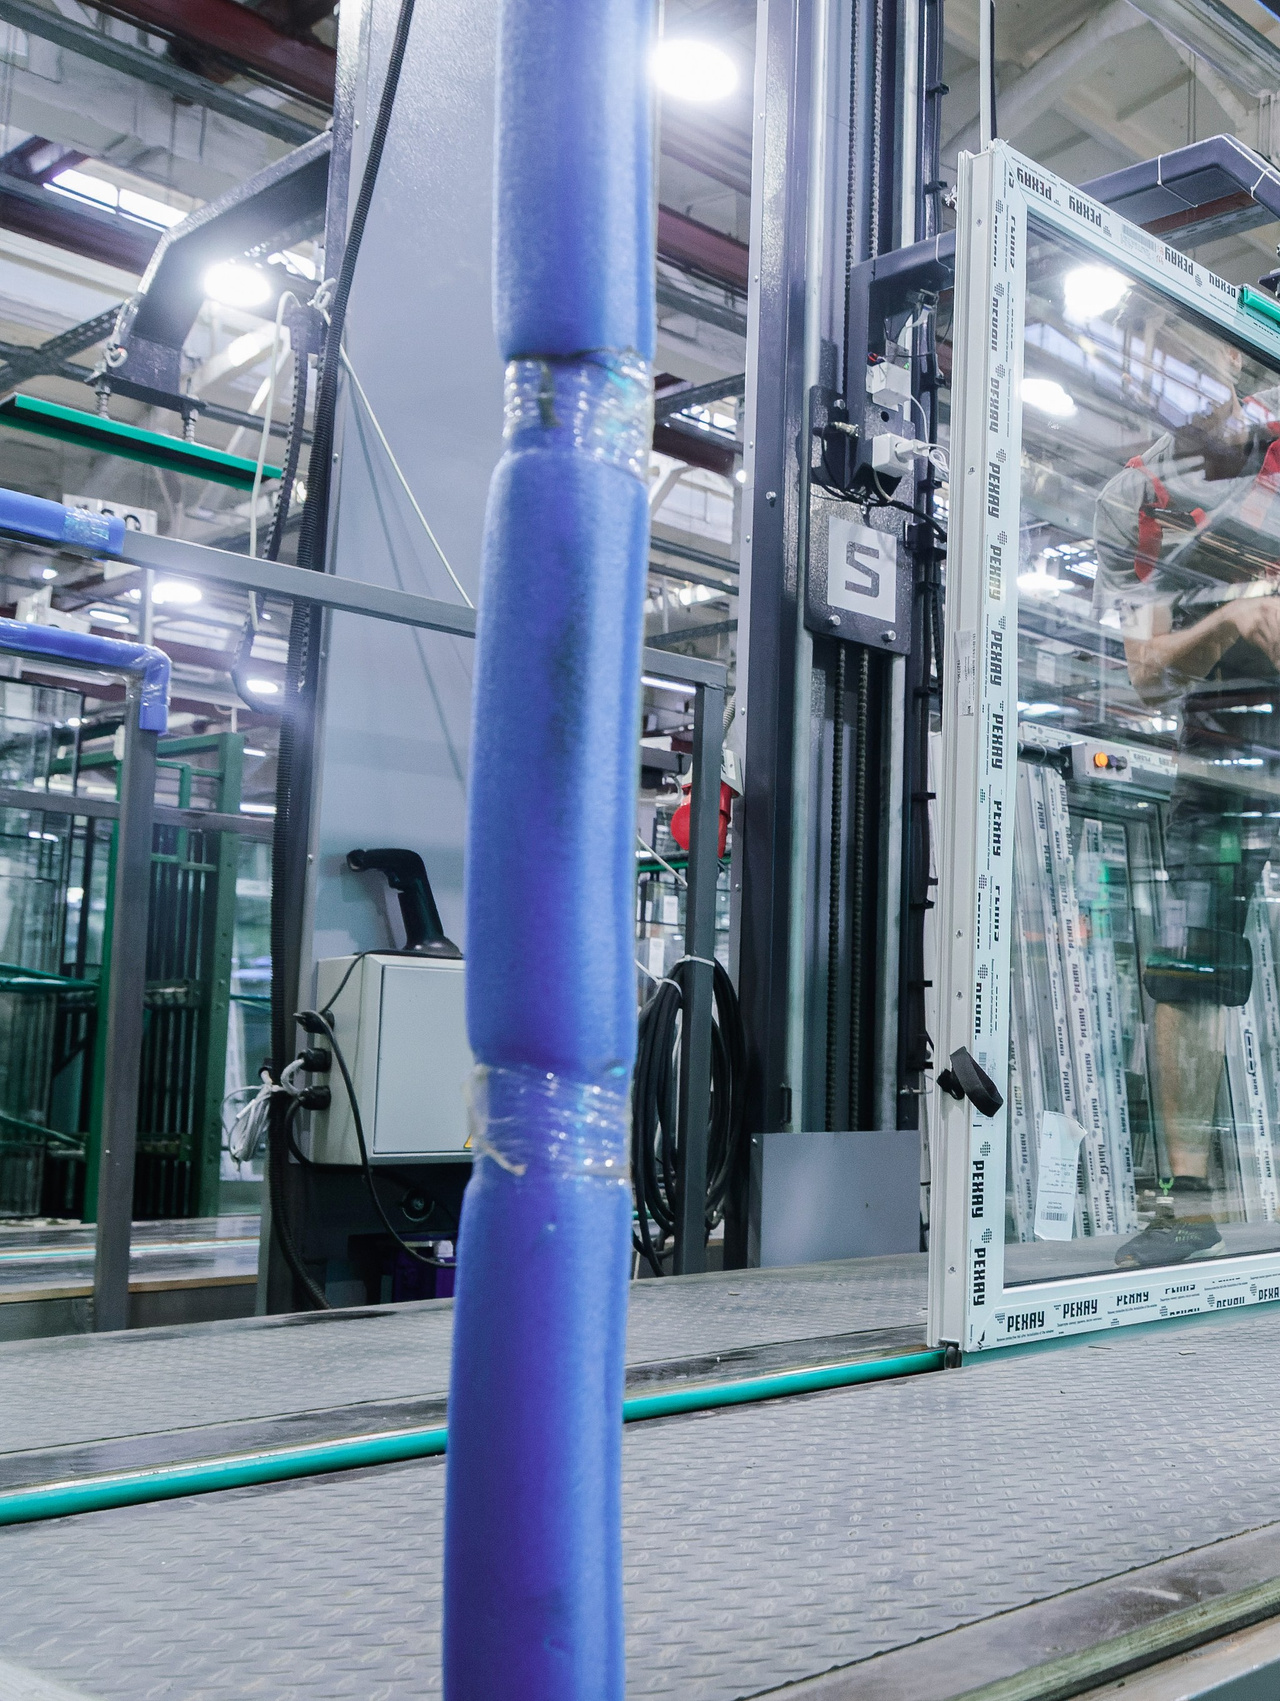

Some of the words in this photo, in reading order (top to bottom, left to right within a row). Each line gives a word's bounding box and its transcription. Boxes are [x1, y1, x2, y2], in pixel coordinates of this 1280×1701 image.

[1017, 166, 1052, 201] РЕХАУ
[1069, 195, 1102, 228] РЕХАУ
[1165, 246, 1194, 276] РЕХАУ
[988, 462, 1001, 519] РЕХАУ
[844, 540, 880, 599] S
[989, 544, 1002, 600] РЕХАУ
[990, 630, 1003, 687] РЕХАУ
[992, 712, 1004, 770] РЕХАУ
[972, 1160, 984, 1218] РЕХАУ
[973, 1248, 986, 1306] РЕХАУ
[1007, 1310, 1045, 1332] РЕХАУ
[1062, 1298, 1098, 1319] РЕХАУ
